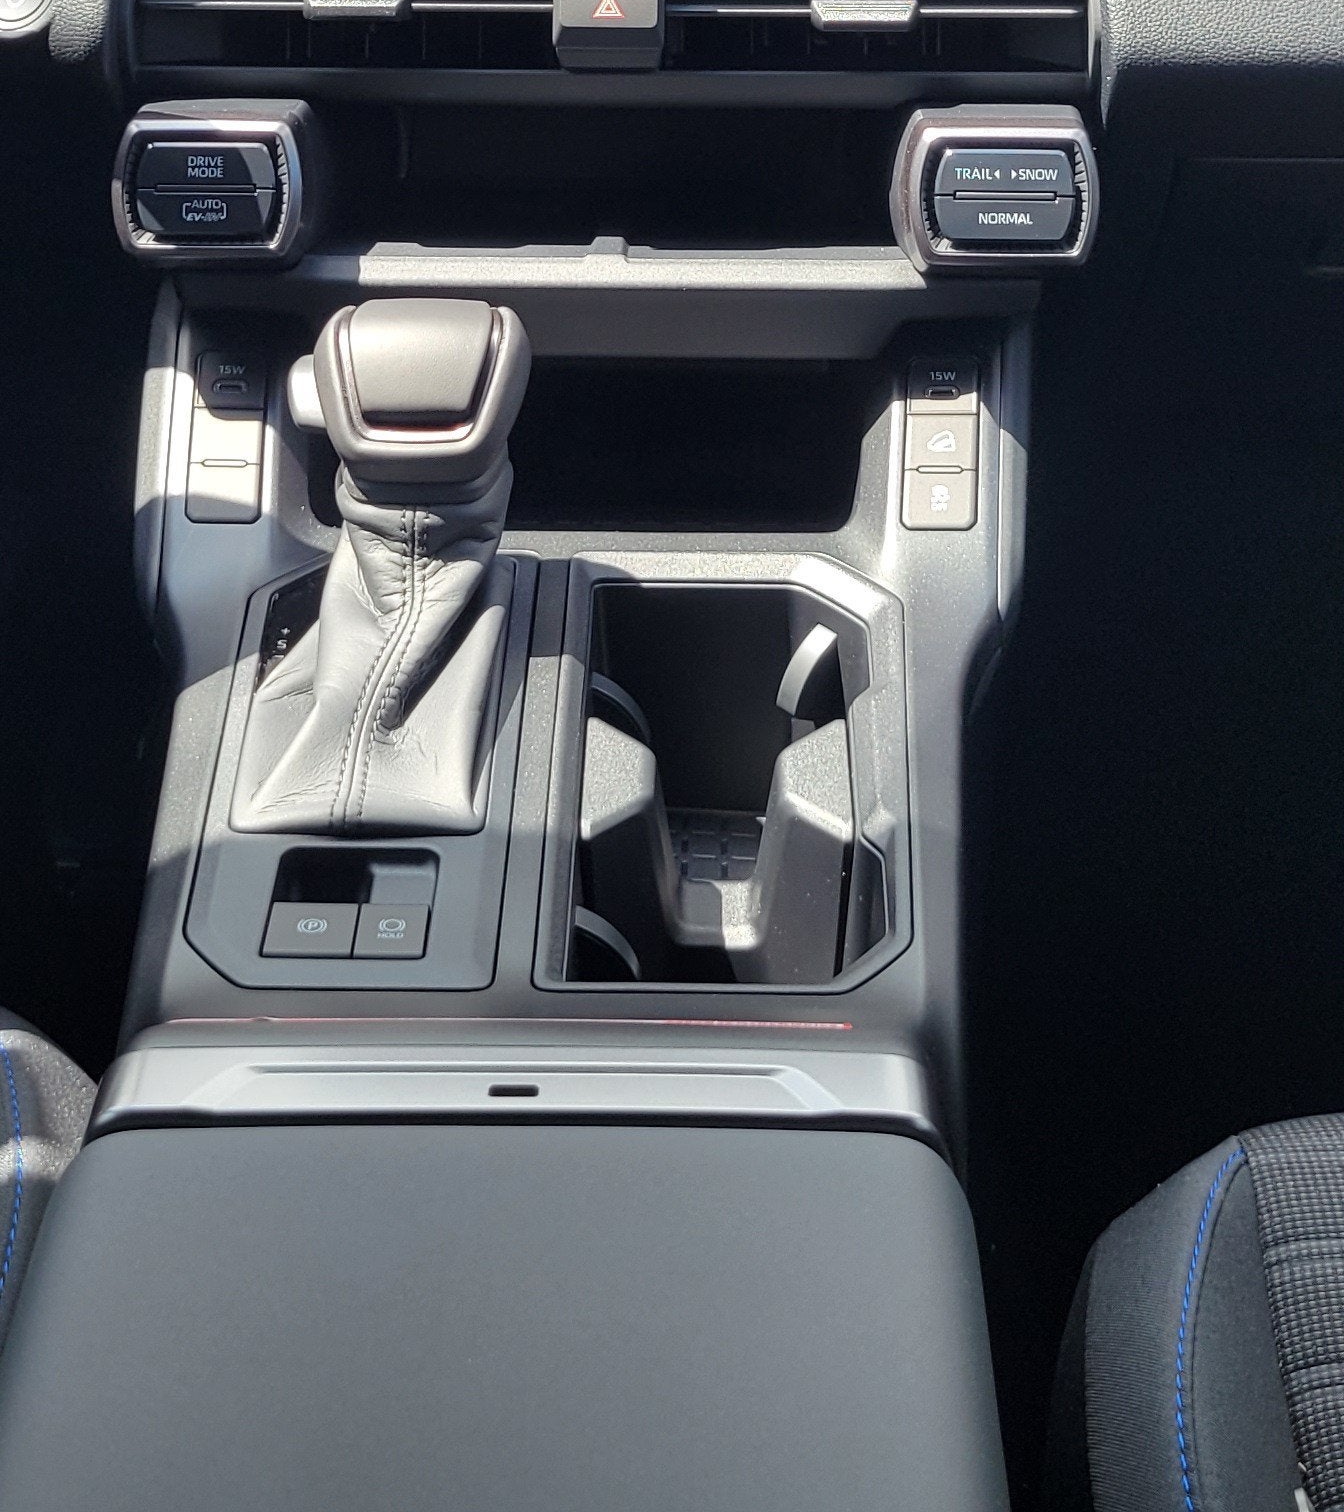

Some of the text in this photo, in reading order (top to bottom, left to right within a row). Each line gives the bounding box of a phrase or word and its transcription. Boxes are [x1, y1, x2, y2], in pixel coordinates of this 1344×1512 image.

[187, 155, 224, 167] DRIVE
[187, 167, 224, 178] MODE
[955, 167, 1058, 181] TRAIL SNOW
[190, 199, 223, 209] AUTO
[977, 212, 1034, 225] NORMAL
[218, 365, 247, 375] 15W
[929, 371, 956, 381] 15W
